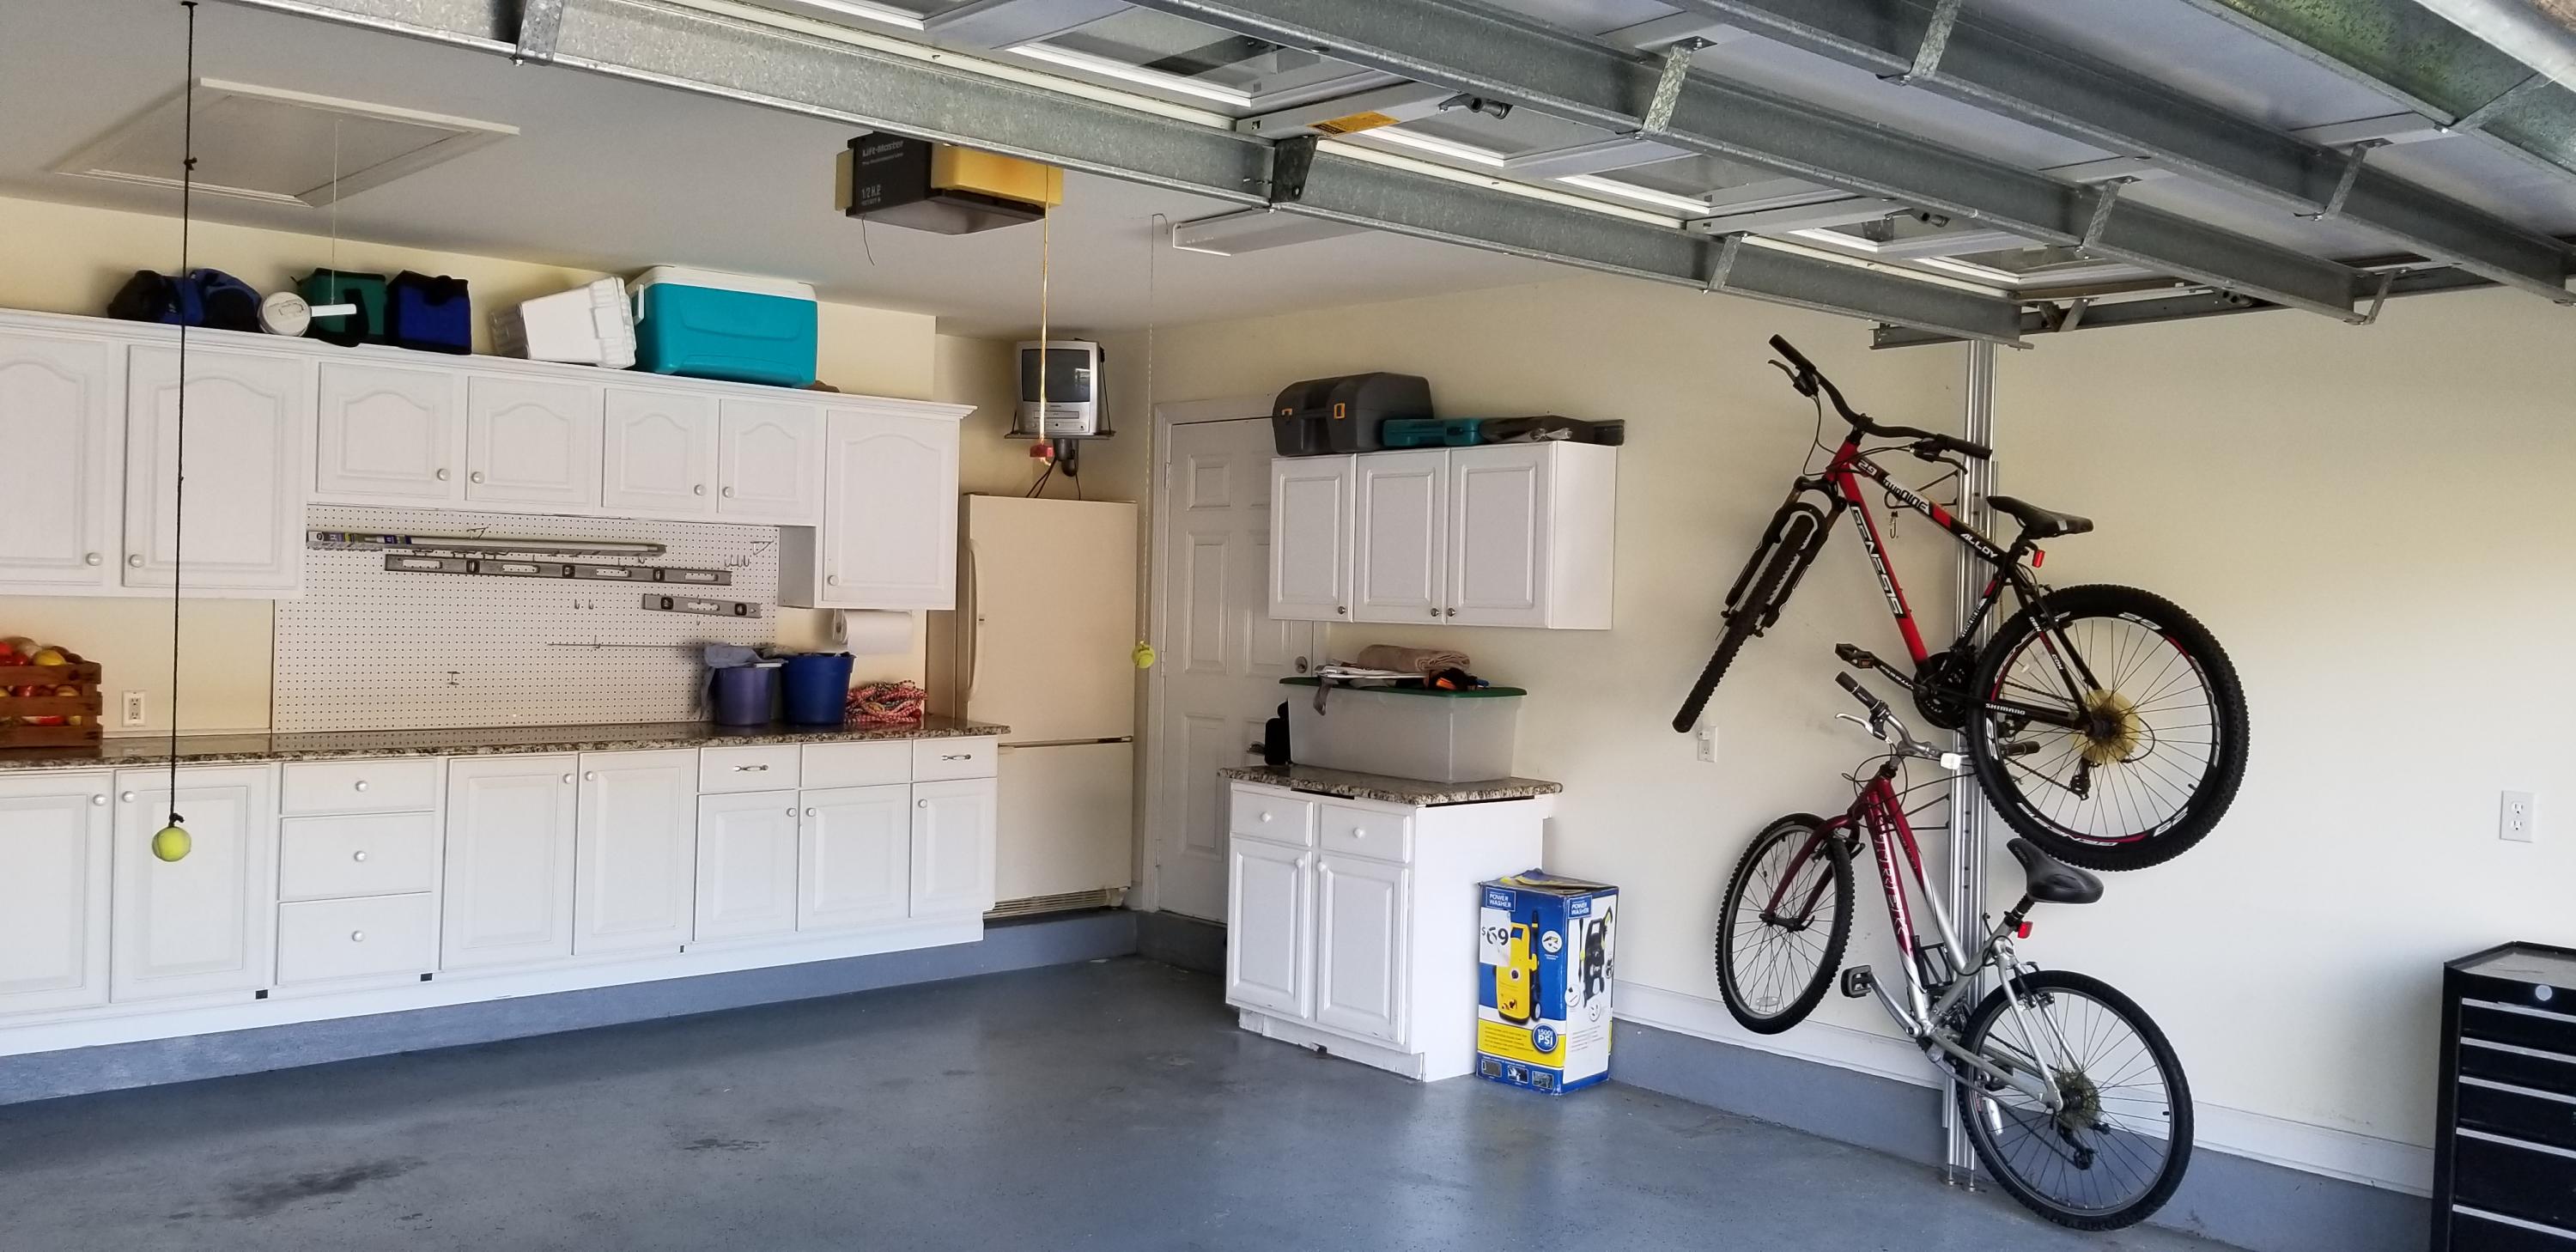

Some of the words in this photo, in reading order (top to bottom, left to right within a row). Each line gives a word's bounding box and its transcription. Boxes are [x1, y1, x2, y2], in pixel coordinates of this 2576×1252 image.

[862, 140, 904, 157] Lift-Master
[1857, 460, 1878, 476] 29
[1959, 532, 1999, 559] ALLOY
[1850, 505, 1904, 615] GENESIS
[1985, 702, 2026, 715] SHIMANO
[1874, 833, 1910, 937] TREK
[1488, 899, 1512, 909] WASHER
[1489, 893, 1510, 903] POWER
[1570, 908, 1590, 916] WASHER
[1571, 902, 1588, 911] POWER
[1537, 1033, 1554, 1046] PSI
